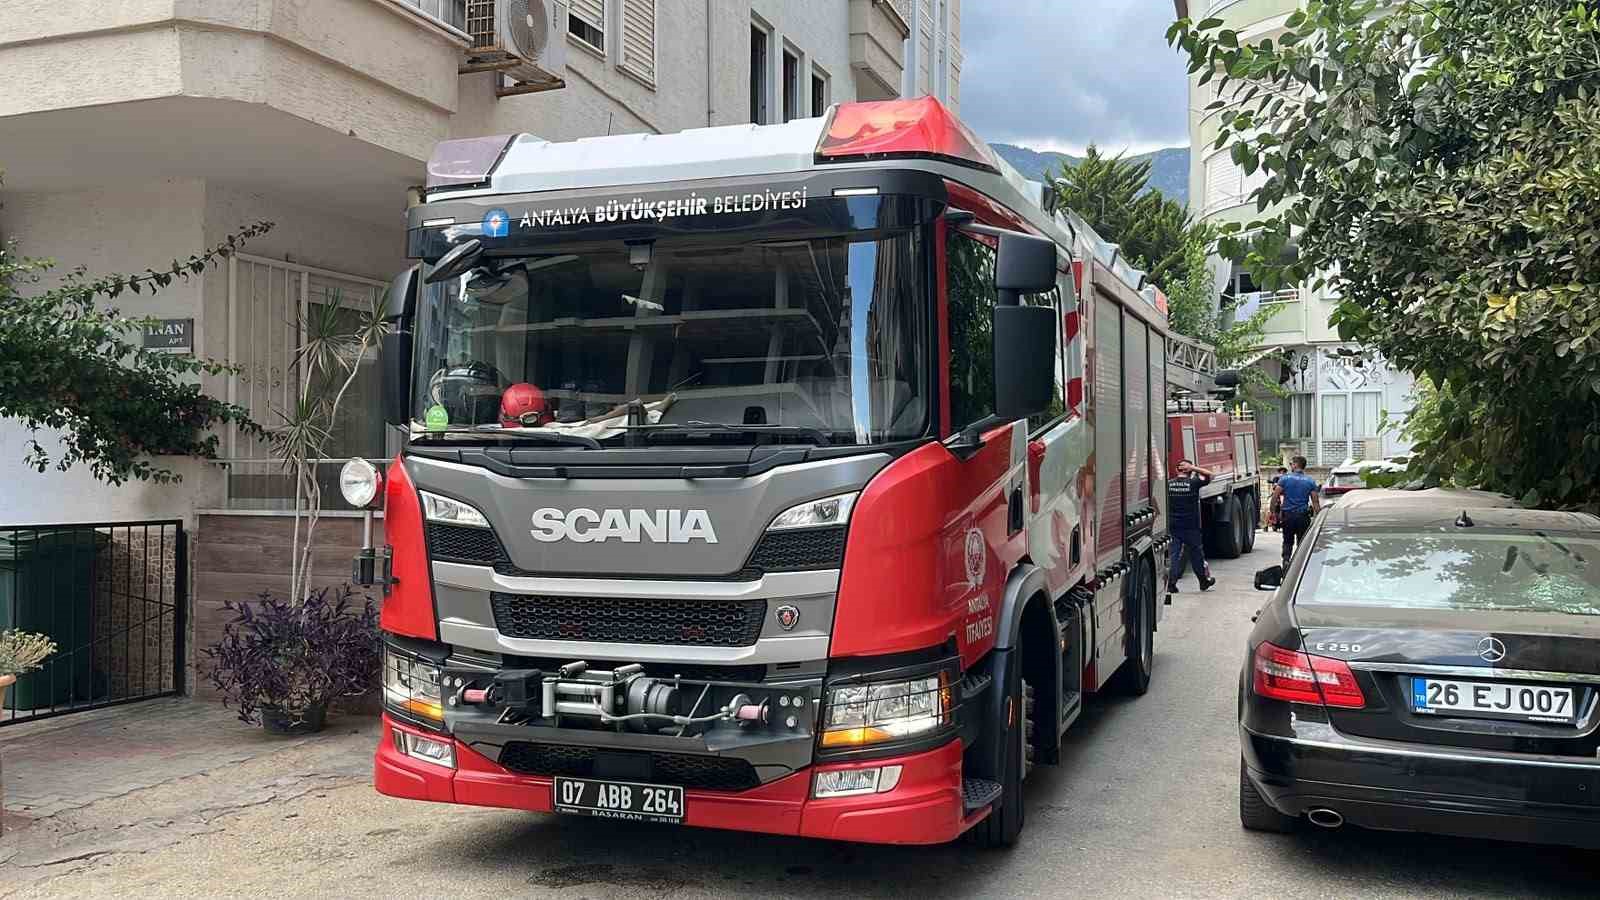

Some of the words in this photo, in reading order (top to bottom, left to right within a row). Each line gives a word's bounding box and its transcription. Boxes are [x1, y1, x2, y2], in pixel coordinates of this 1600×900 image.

[519, 207, 590, 228] ANTALYA
[594, 192, 708, 222] BÜYÜKŞEHİR
[713, 186, 808, 214] BELEDİYESİ
[530, 507, 719, 544] SCANIA
[968, 592, 990, 614] ANTALYA
[1316, 643, 1325, 651] E
[1327, 643, 1361, 653] 250
[1415, 694, 1426, 703] TR
[1427, 682, 1459, 706] 26
[1472, 686, 1512, 712] EJ
[1518, 688, 1570, 714] 007
[562, 781, 585, 804] 07
[597, 784, 632, 809] ABB
[642, 788, 679, 813] 264
